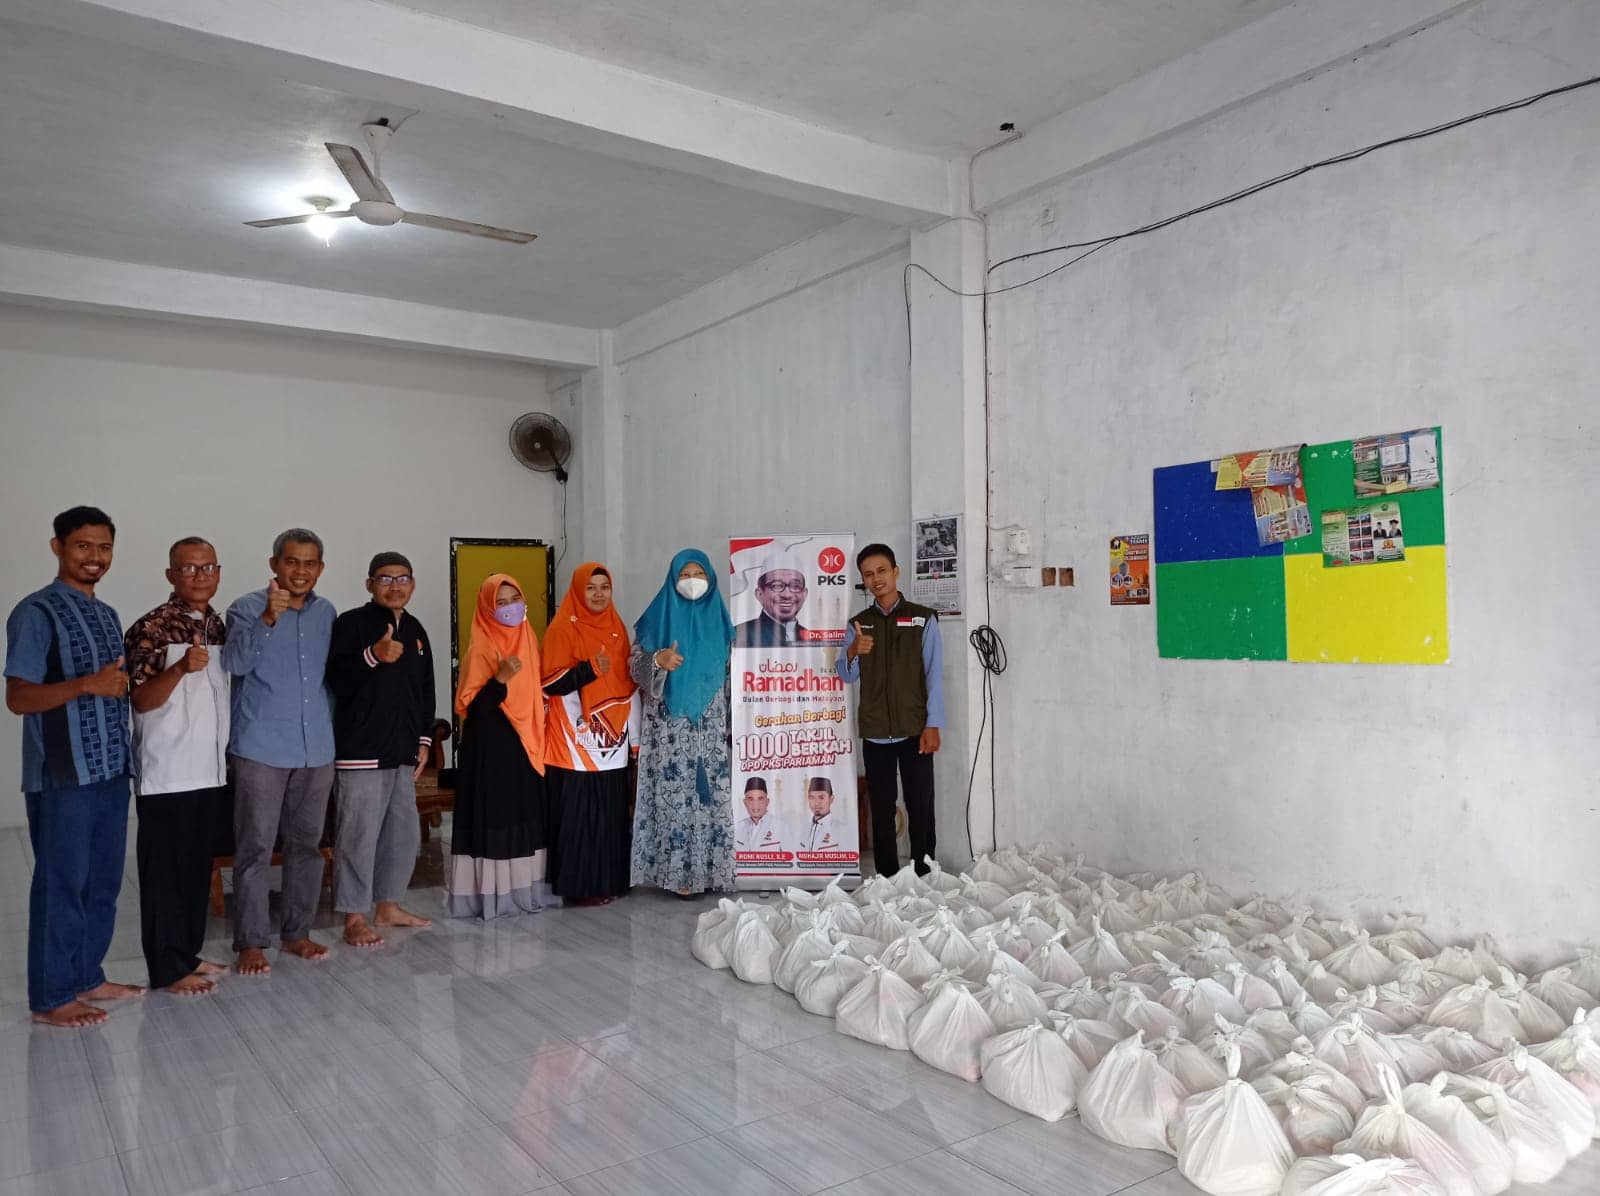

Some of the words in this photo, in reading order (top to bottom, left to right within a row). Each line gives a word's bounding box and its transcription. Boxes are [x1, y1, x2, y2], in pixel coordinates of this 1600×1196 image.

[817, 575, 846, 586] PKS
[809, 631, 822, 640] Dr.
[744, 668, 843, 691] Ramadhan
[796, 695, 810, 703] dan
[756, 713, 801, 727] Gerakan
[803, 707, 846, 723] Berbagi
[737, 731, 789, 760] 1000
[789, 727, 837, 743] TAKJIL
[790, 738, 852, 756] BERKAH
[741, 760, 761, 772] DPD
[762, 757, 783, 771] PKS
[782, 753, 836, 769] PARIAMAN
